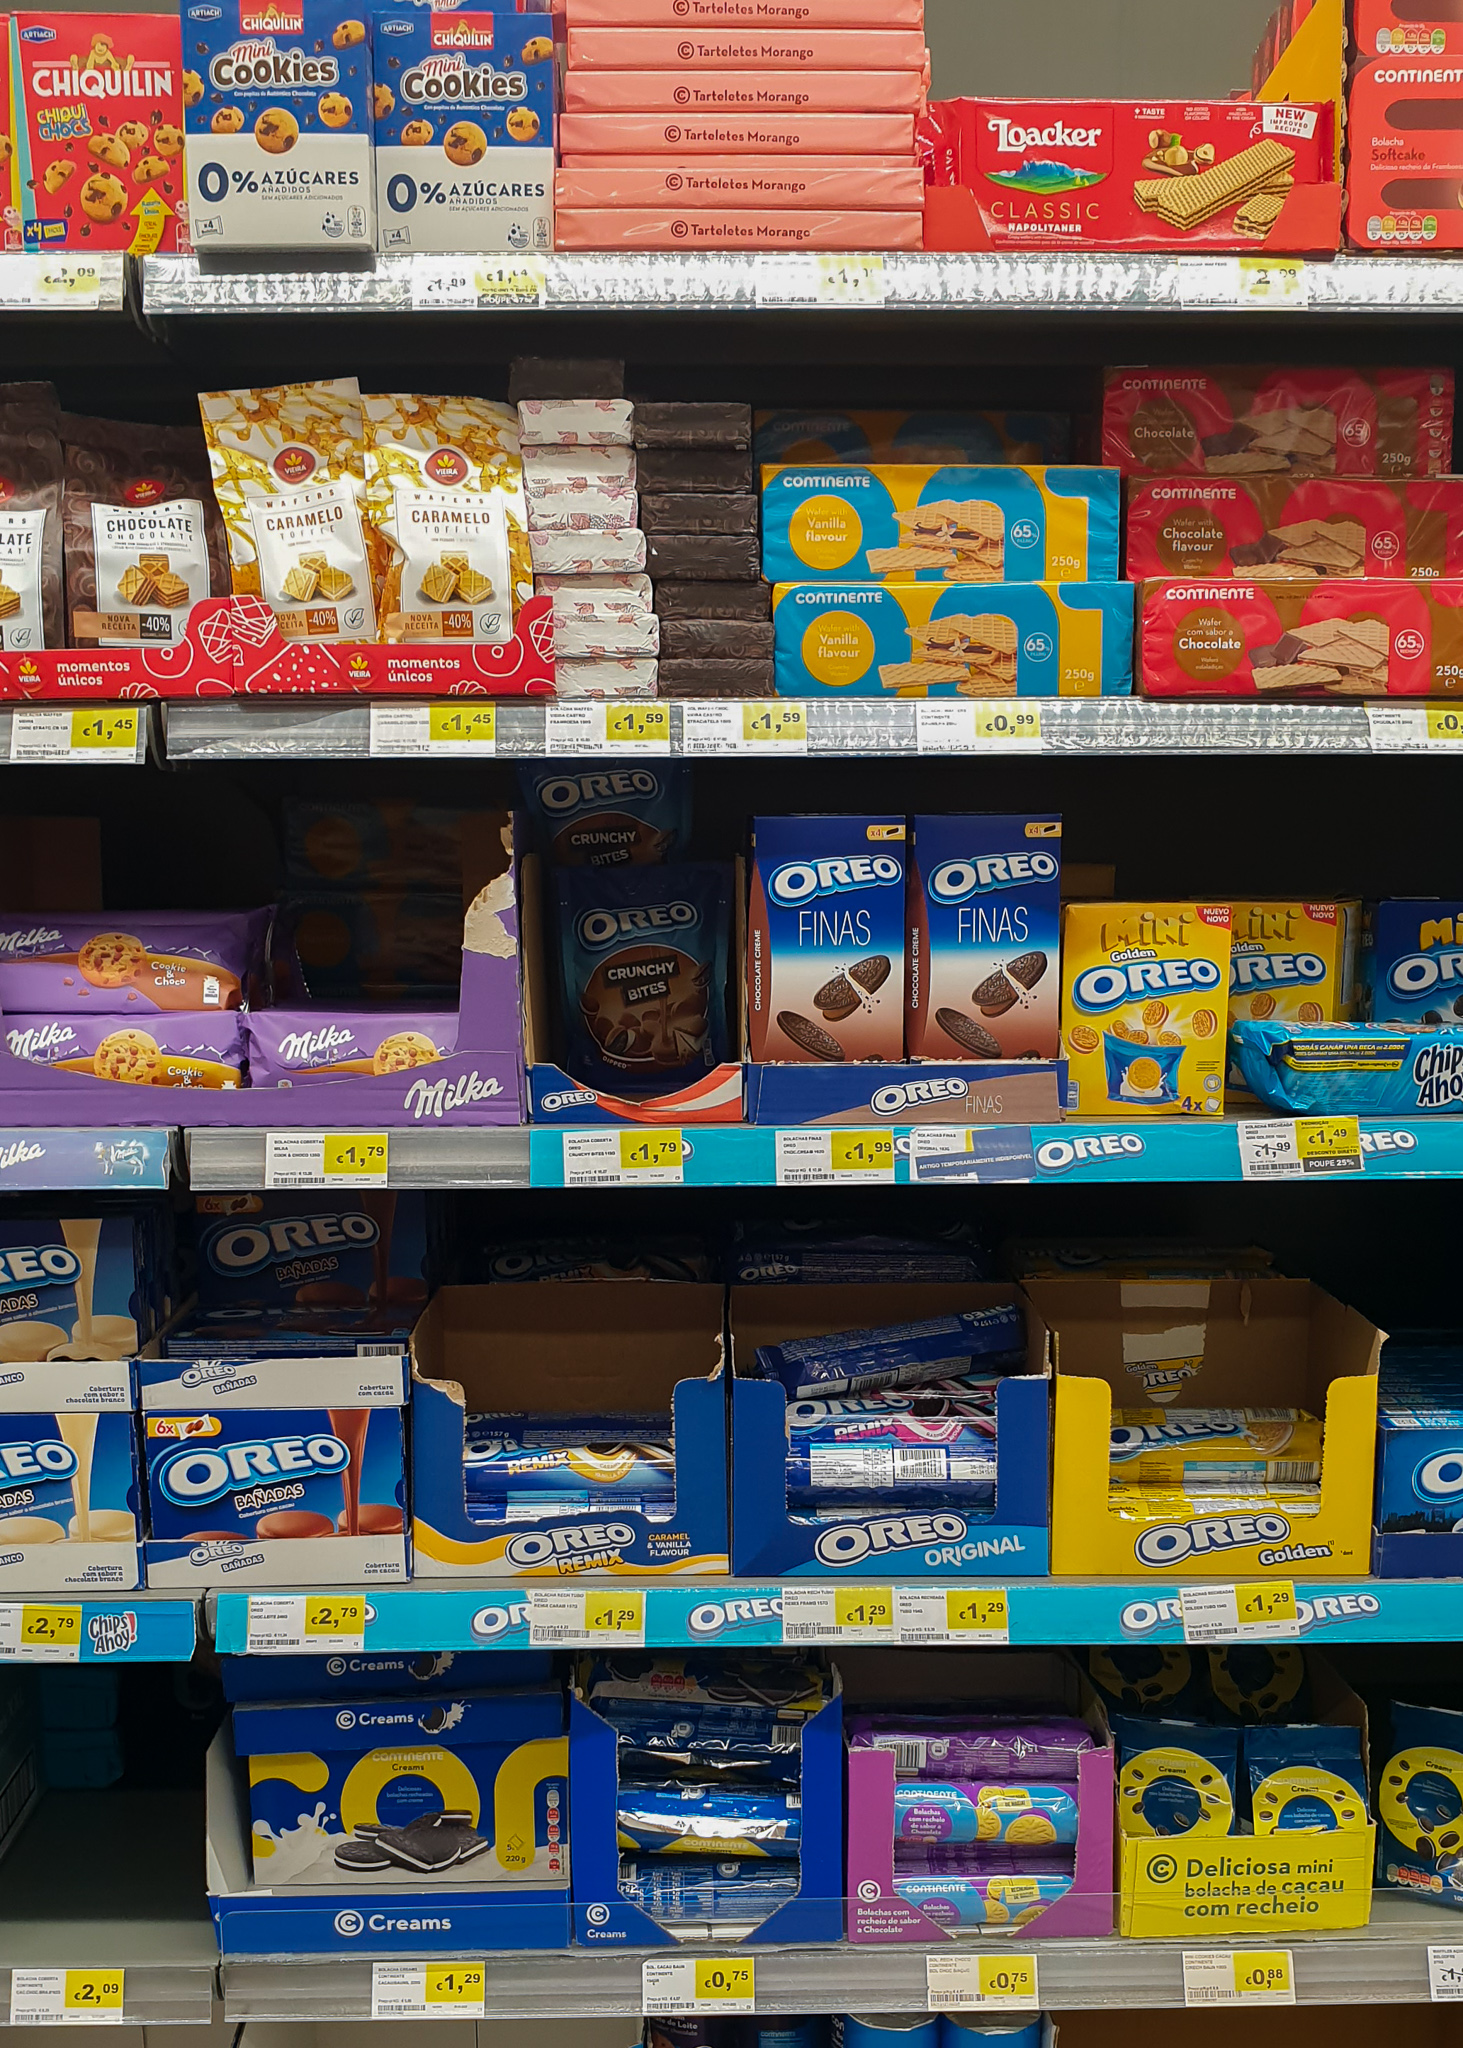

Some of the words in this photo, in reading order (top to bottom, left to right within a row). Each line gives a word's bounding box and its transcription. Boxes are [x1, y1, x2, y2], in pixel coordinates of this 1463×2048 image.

[242, 17, 302, 31] CHIQUILIN
[433, 34, 492, 47] CHIQUILIN
[213, 53, 334, 85] Cookies
[423, 57, 463, 78] Mini
[32, 70, 172, 99] CHIQUILIN
[404, 68, 523, 100] Cookies
[1275, 109, 1305, 120] NEW
[1270, 119, 1308, 129] IMPROVED
[1275, 125, 1301, 134] RECIPE
[987, 118, 1102, 153] Loacker
[1371, 137, 1404, 146] Bolacha
[1371, 149, 1425, 161] Softcake
[261, 168, 359, 185] AZÚCARES
[686, 177, 748, 190] Tarteletes
[752, 179, 805, 194] Morango
[262, 185, 311, 193] AÑADIDOS
[449, 180, 545, 197] AZÚCARES
[990, 201, 1100, 220] CLASSIC
[691, 224, 753, 237] Tarteletes
[757, 226, 810, 240] Morango
[1008, 223, 1082, 233] NAPOLITANER
[1122, 379, 1207, 390] CONTINENTE
[1134, 426, 1195, 439] Chocolate
[1382, 452, 1411, 466] 250g
[284, 464, 307, 474] VIEIRA
[434, 467, 458, 476] VIEIRA
[782, 476, 870, 488] CONTINENTE
[266, 488, 336, 508] WAFERS
[1151, 487, 1236, 500] CONTINENTE
[106, 517, 193, 533] CHOCOLATE
[266, 506, 343, 531] CARAMELO
[411, 510, 490, 524] CARAMELO
[808, 516, 847, 530] Vanilla
[805, 530, 848, 542] flavour
[1163, 528, 1224, 540] Chocolate
[1172, 540, 1214, 552] flavour
[795, 592, 883, 604] CONTINENTE
[1165, 588, 1255, 600] CONTINENTE
[1198, 618, 1222, 627] Wafer
[820, 633, 859, 646] Vanilla
[1178, 637, 1242, 651] Chocolate
[818, 647, 860, 659] flavour
[56, 660, 130, 672] momentos
[387, 657, 460, 670] momentos
[57, 674, 104, 686] únicos
[387, 670, 433, 683] únicos
[83, 719, 133, 740] €1,45
[441, 714, 491, 734] €1,45
[614, 713, 664, 733] €1,59
[541, 774, 654, 809] OREO
[570, 831, 637, 845] CRUNCHY
[775, 857, 898, 899] OREO
[934, 855, 1054, 896] OREO
[583, 904, 692, 942] OREO
[798, 910, 871, 946] FINAS
[958, 906, 1029, 943] FINAS
[0, 927, 63, 951] Milka
[911, 927, 919, 955] CREME
[1111, 949, 1157, 962] Golden
[151, 962, 186, 973] Cookie
[166, 970, 174, 978] &
[607, 961, 675, 981] CRUNCHY
[154, 977, 186, 986] Choco
[911, 957, 919, 1009] CHOCOLATE
[1079, 961, 1218, 1004] OREO
[628, 981, 667, 1001] BITES
[6, 1022, 77, 1057] Milka
[278, 1025, 355, 1060] Milka
[403, 1071, 504, 1119] Milka
[543, 1091, 595, 1108] OREO
[874, 1080, 965, 1112] OREO
[1181, 1096, 1202, 1112] 4x
[965, 1095, 1003, 1114] FINAS
[1308, 1128, 1347, 1146] €1,49
[336, 1146, 385, 1167] €1,79
[630, 1142, 677, 1164] €1,79
[844, 1141, 892, 1164] €1,99
[1037, 1134, 1143, 1168] OREO
[1255, 1141, 1291, 1158] €1,99
[919, 1162, 940, 1170] ARTIGO
[941, 1158, 994, 1168] TEMPORARIAMENTE
[995, 1154, 1032, 1163] INDISPONÍVEL
[1309, 1159, 1335, 1168] POUPE
[1336, 1158, 1355, 1166] 25%
[214, 1216, 375, 1267] OREO
[275, 1257, 339, 1281] BAÑADAS
[183, 1366, 236, 1385] OREO
[214, 1376, 257, 1393] BAÑADAS
[155, 1420, 175, 1435] 6x
[834, 1418, 896, 1441] REMIX
[168, 1439, 344, 1496] OREO
[507, 1451, 571, 1475] REMIX
[235, 1484, 305, 1510] BAÑADAS
[509, 1526, 631, 1564] OREO
[648, 1533, 690, 1541] CARAMEL
[820, 1516, 963, 1561] OREO
[1139, 1516, 1286, 1560] OREO
[191, 1544, 244, 1564] OREO
[650, 1549, 689, 1557] FLAVOUR
[925, 1534, 1025, 1566] ORIGINAL
[1260, 1544, 1331, 1564] Golden
[222, 1555, 264, 1572] BAÑADAS
[1245, 1592, 1290, 1615] €1,29
[311, 1608, 358, 1628] €2,79
[846, 1605, 886, 1625] €1,29
[959, 1603, 1004, 1623] €1,29
[28, 1617, 74, 1638] €2,79
[90, 1614, 128, 1638] Chips
[359, 1712, 415, 1726] Creams
[392, 1763, 425, 1772] Creams
[1158, 1766, 1187, 1775] Creams
[683, 1838, 748, 1849] CONTINENTE
[1186, 1856, 1291, 1878] Deliciosa
[1297, 1859, 1333, 1874] mini
[906, 1884, 966, 1893] CONTINENTE
[1185, 1882, 1251, 1898] bolacha
[1255, 1883, 1277, 1896] de
[1281, 1878, 1345, 1893] cacau
[857, 1908, 892, 1917] Bolachas
[1184, 1902, 1229, 1917] com
[1236, 1896, 1319, 1915] recheio
[368, 1914, 452, 1932] Creams
[857, 1918, 883, 1926] recheio
[884, 1918, 895, 1926] de
[896, 1916, 921, 1925] sabor
[863, 1925, 903, 1933] Chocolate
[587, 1929, 627, 1938] Creams
[436, 1973, 480, 1994] €1,29
[704, 1970, 749, 1991] €0,75
[989, 1972, 1028, 1993] €0,75
[1245, 1969, 1283, 1989] €0,88
[74, 1983, 119, 2004] €2,09
